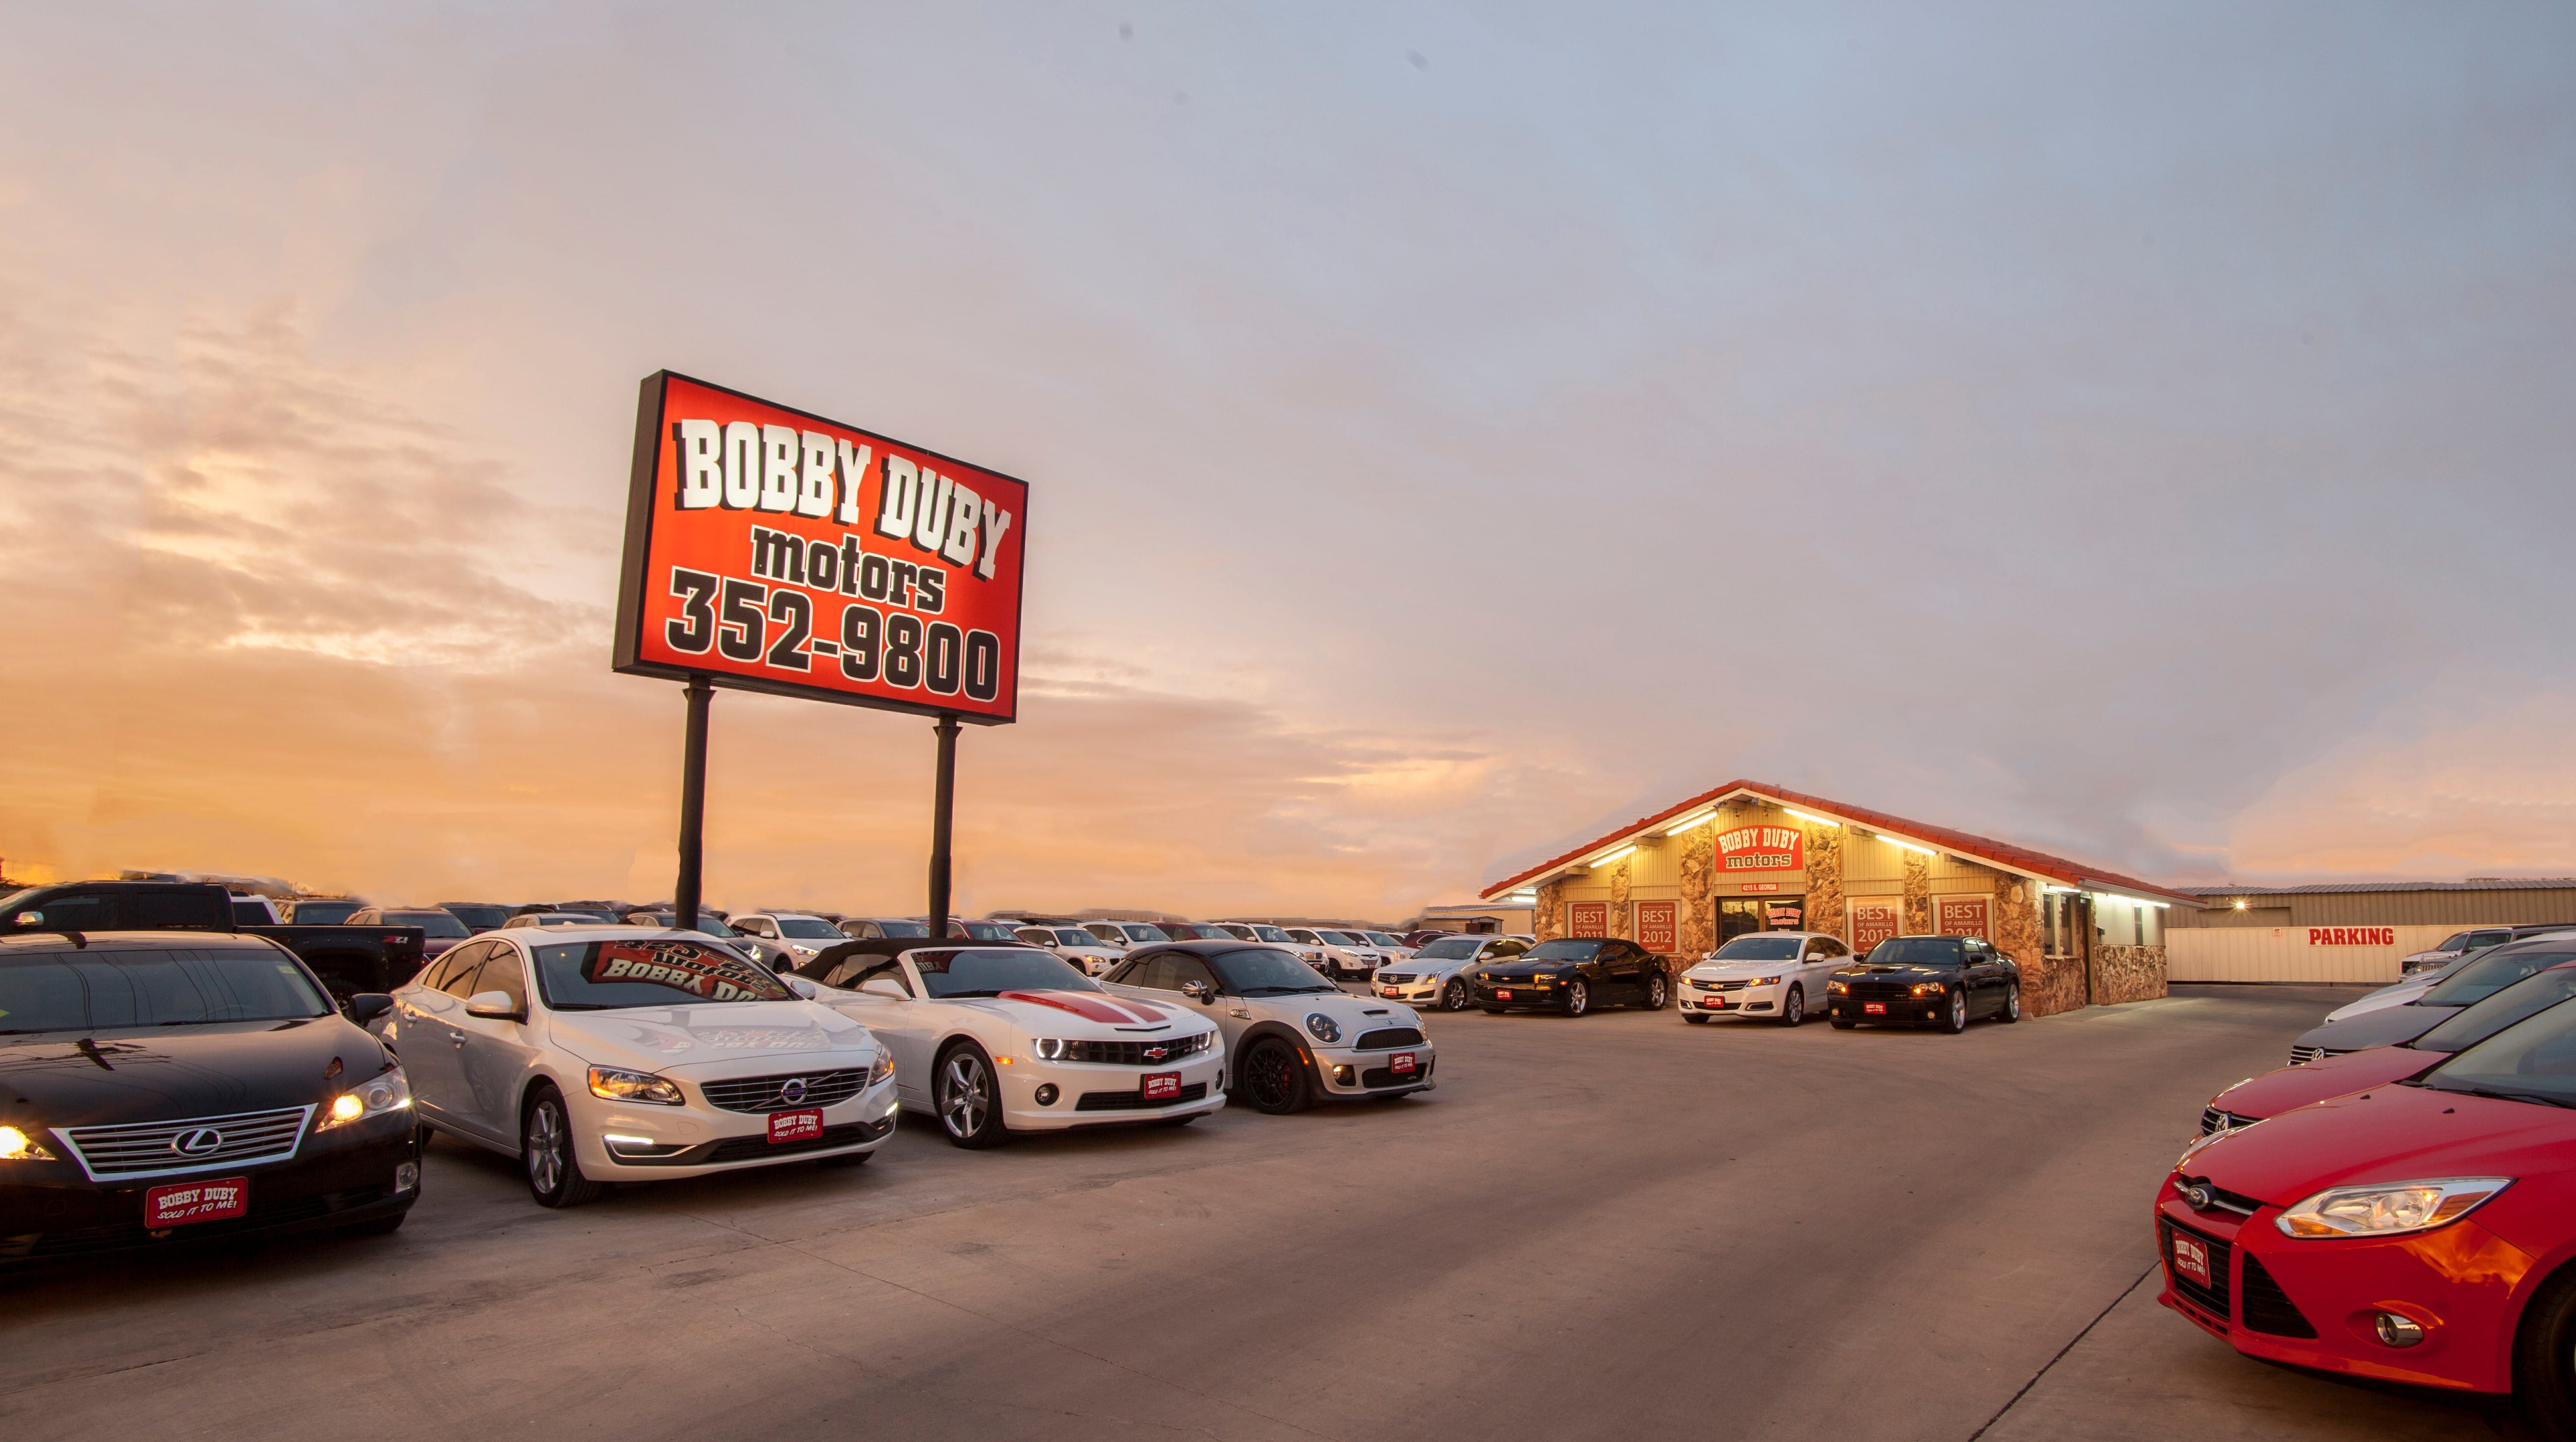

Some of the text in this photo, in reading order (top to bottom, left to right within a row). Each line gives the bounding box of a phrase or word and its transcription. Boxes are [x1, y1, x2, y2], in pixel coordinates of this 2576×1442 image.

[674, 419, 1011, 582] BOBBY DUBY
[751, 524, 946, 615] motors
[665, 565, 1000, 702] 352-9800
[1718, 828, 1799, 854] BOBBY DUBY
[1726, 852, 1791, 869] motors
[1575, 911, 1604, 923] BEST
[1642, 911, 1672, 923] BEST
[1768, 907, 1801, 919] BOBBY DUBY
[1857, 906, 1893, 920] BEST
[1944, 904, 1983, 919] BEST
[1642, 931, 1672, 943] 2012
[2309, 928, 2394, 945] PARKING
[1148, 1078, 1177, 1089] BOBBY DUBY
[774, 1115, 817, 1130] BOBBY DUBY
[158, 1187, 238, 1210] BOBBY DUBY
[157, 1200, 237, 1219] SOLD IT TO ME!
[2175, 1240, 2204, 1266] BOBBY DUBY
[2177, 1257, 2205, 1276] SOLD IT TO ME!
